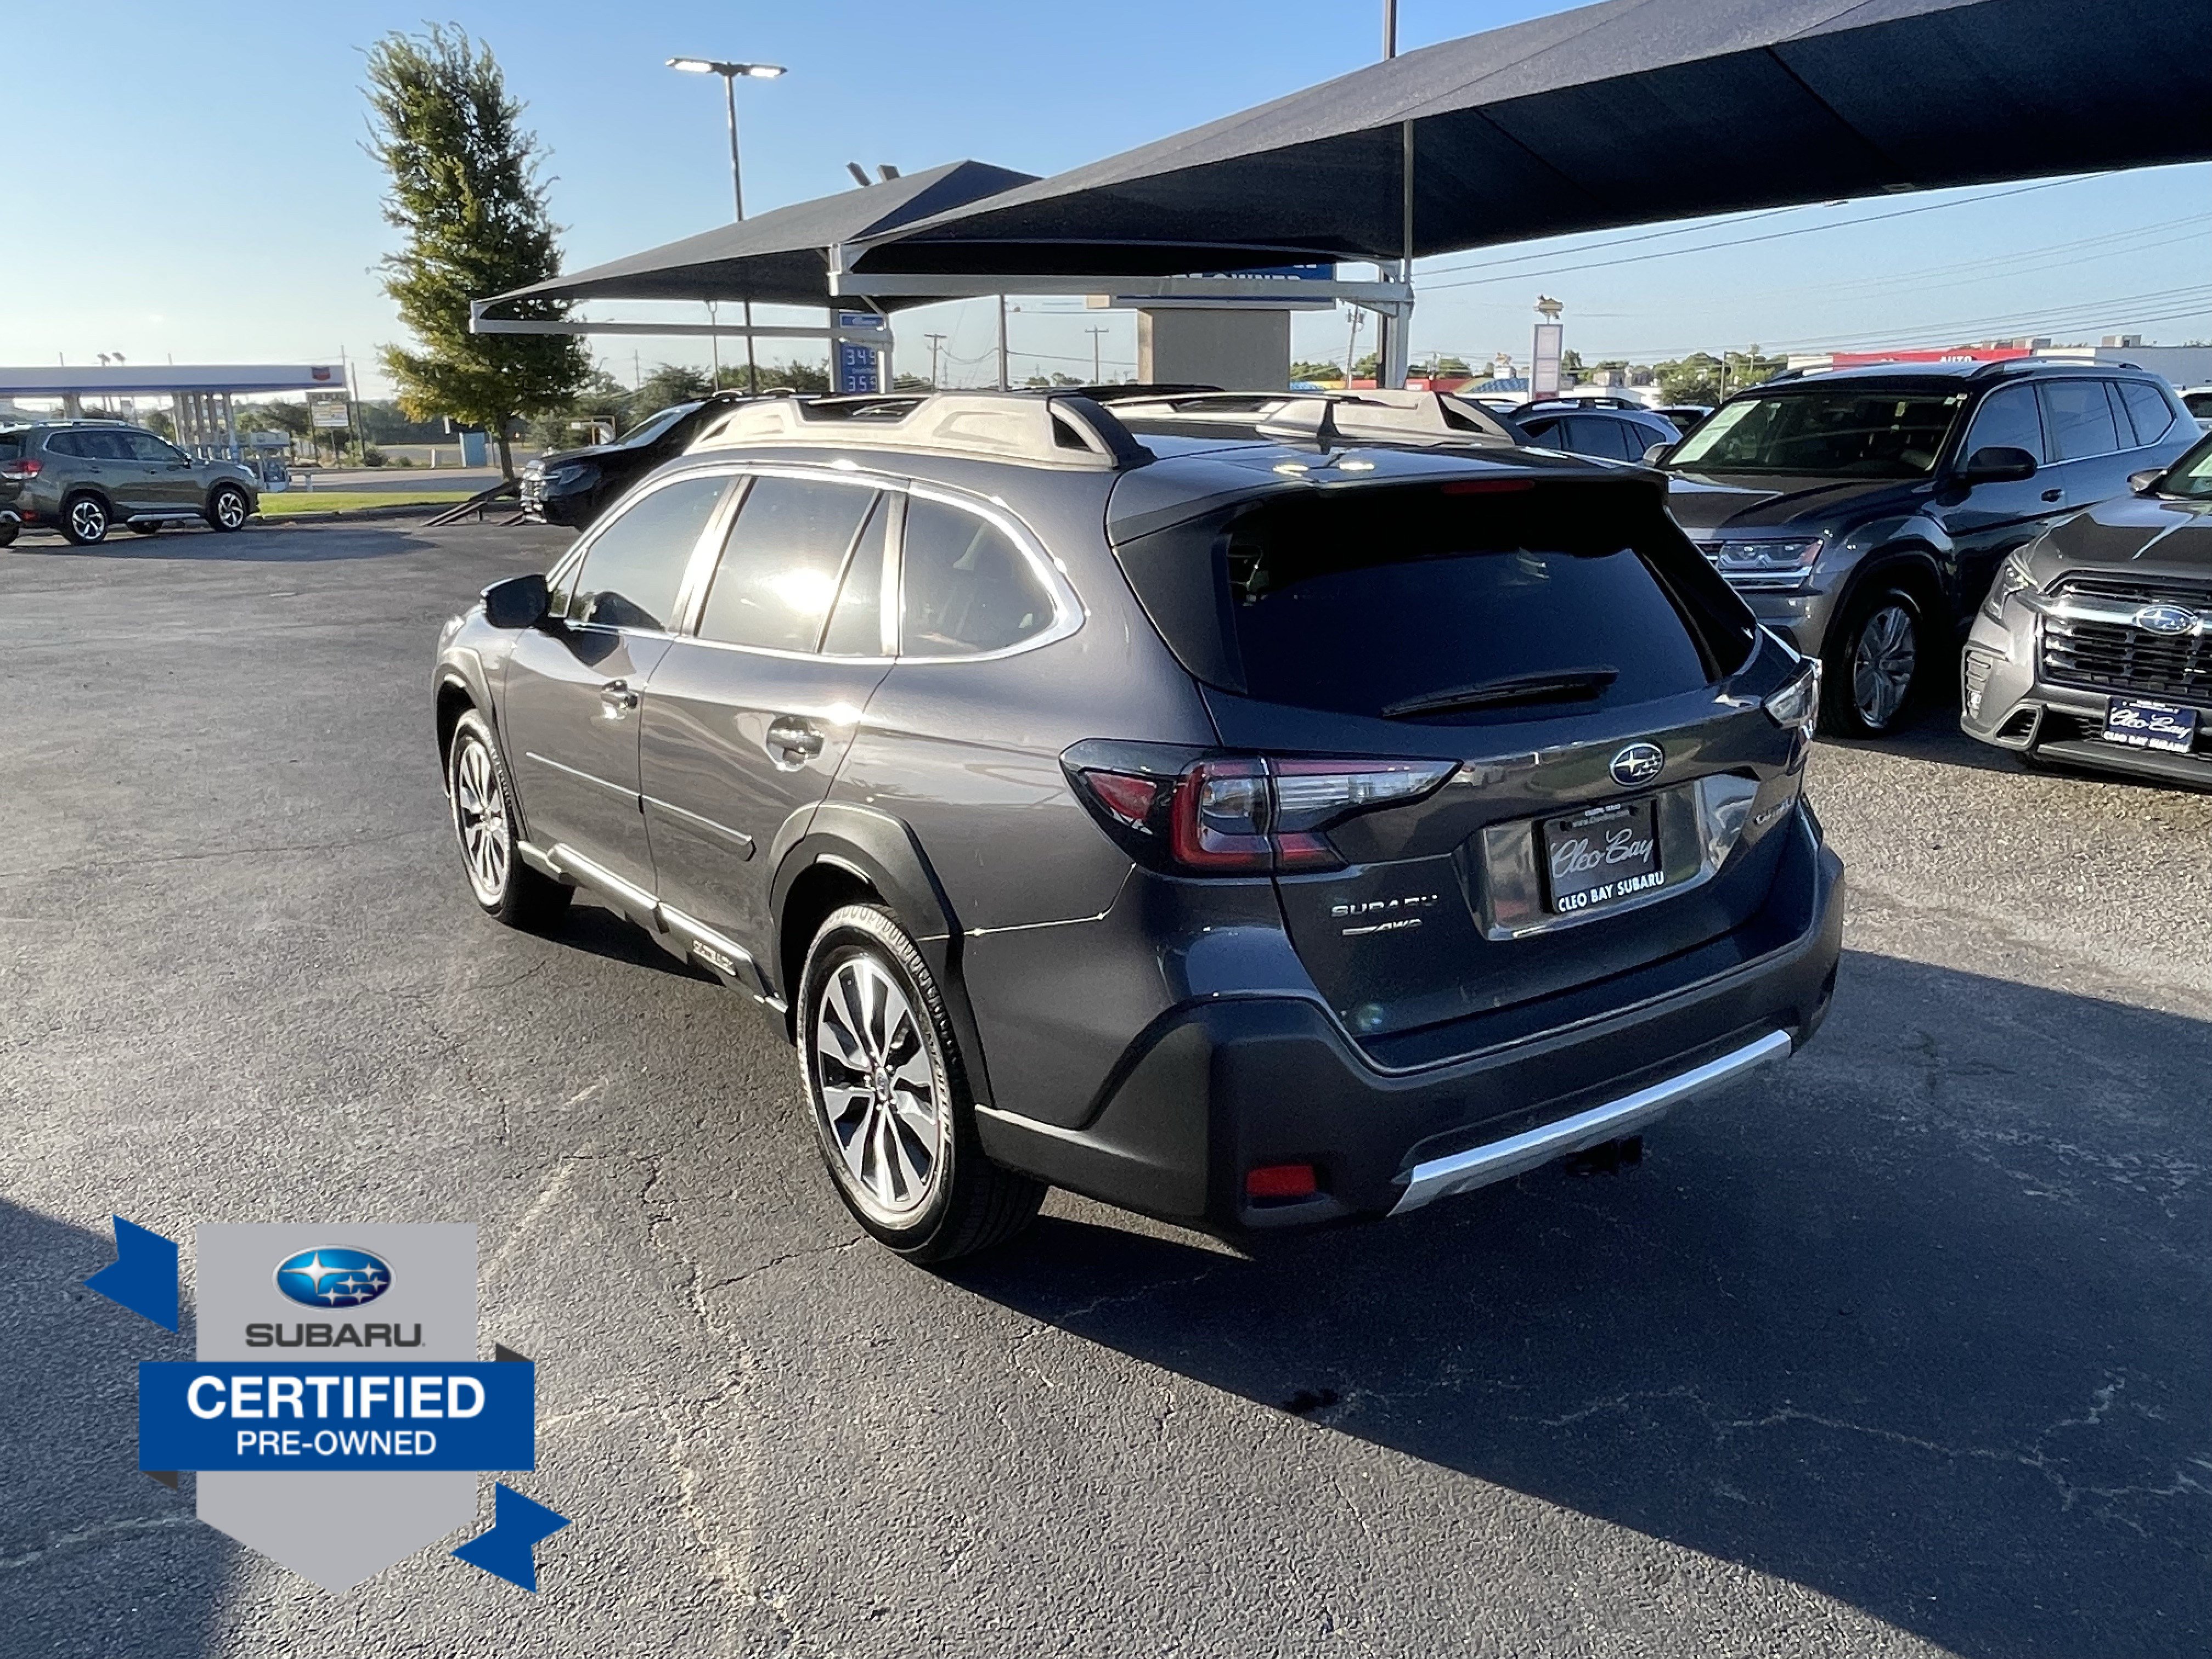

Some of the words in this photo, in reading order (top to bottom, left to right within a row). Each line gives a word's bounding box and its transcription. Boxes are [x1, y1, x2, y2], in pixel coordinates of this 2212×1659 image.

[1550, 838, 1605, 878] Cleo
[1605, 828, 1654, 863] Bay
[1558, 892, 1588, 912] CLEO
[1590, 884, 1613, 903] BAY
[1617, 871, 1665, 895] SUBARU
